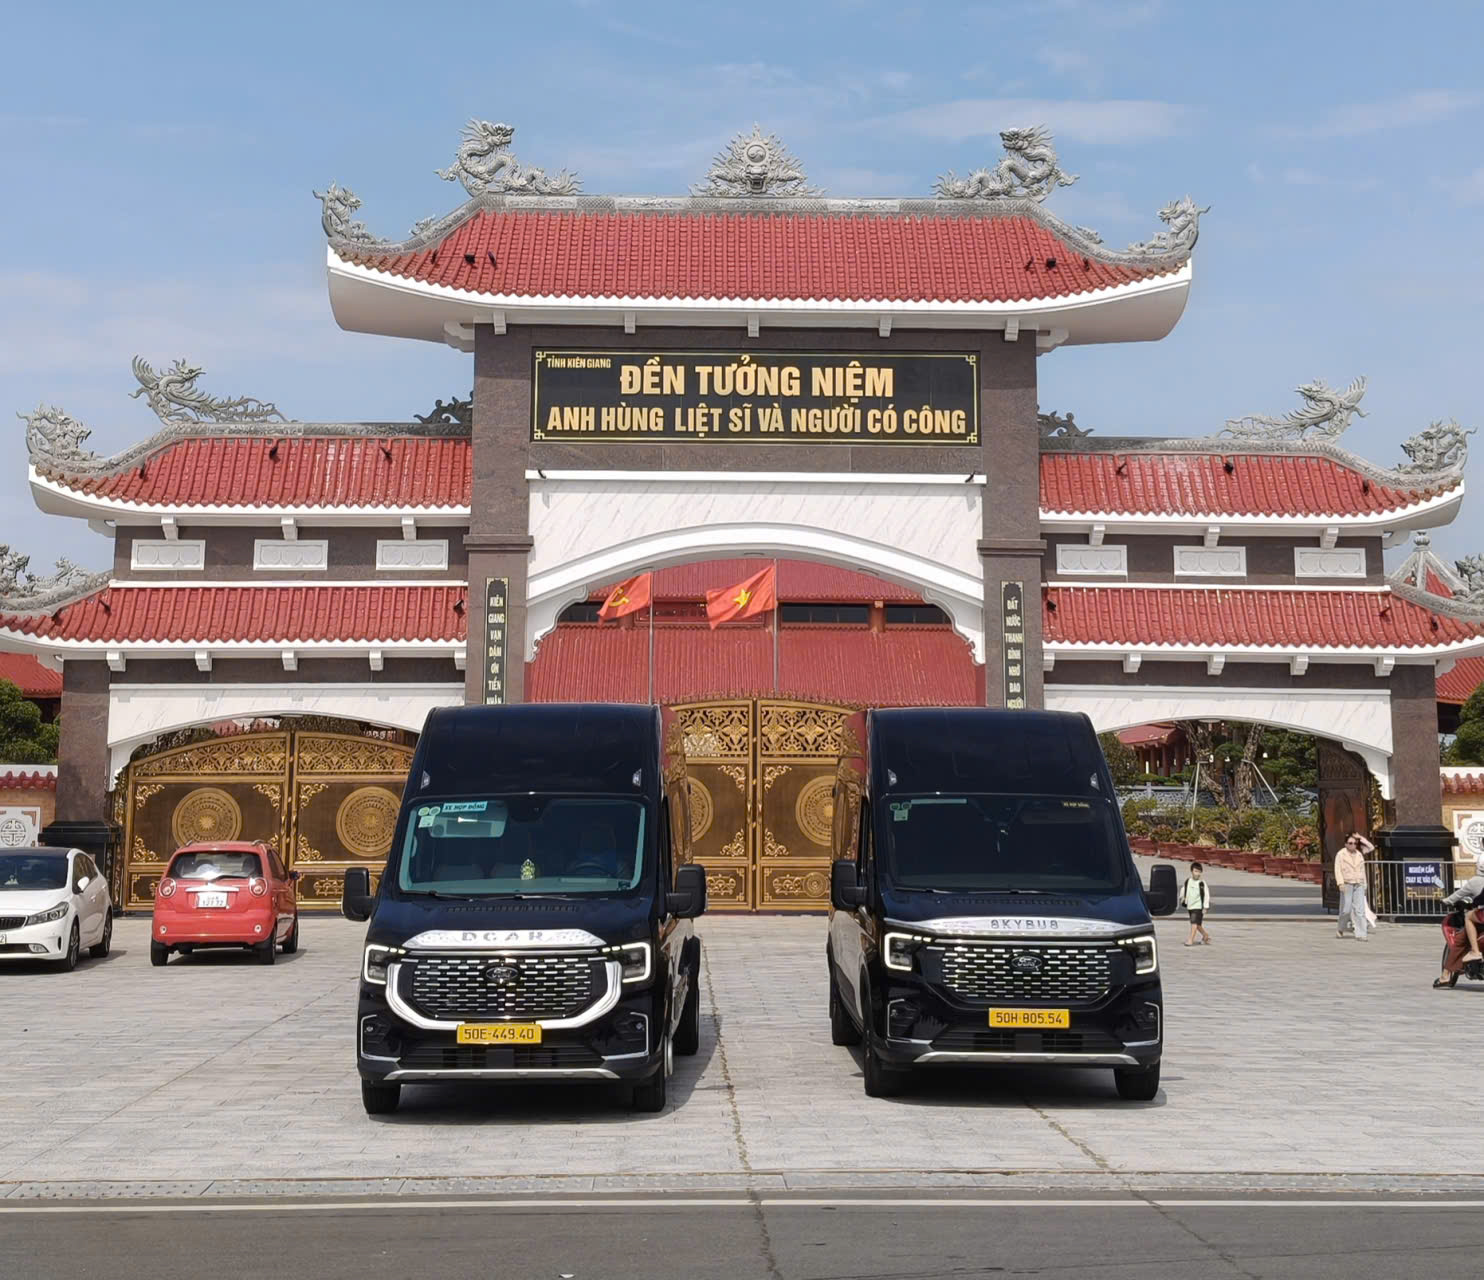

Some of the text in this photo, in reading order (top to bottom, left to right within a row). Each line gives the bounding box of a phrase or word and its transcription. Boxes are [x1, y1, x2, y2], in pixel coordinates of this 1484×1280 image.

[547, 355, 611, 369] TỈNH KIÊN GIANG
[620, 354, 893, 403] ĐỀN TƯỞNG NIỆM
[547, 402, 966, 437] ANH HÙNG LIỆT SĨ VÀ NGƯỜI CÓ CÔNG
[488, 613, 505, 624] GIANG
[490, 630, 502, 642] VẠN
[462, 931, 544, 942] DCAR
[464, 1028, 534, 1040] 50E-449.40
